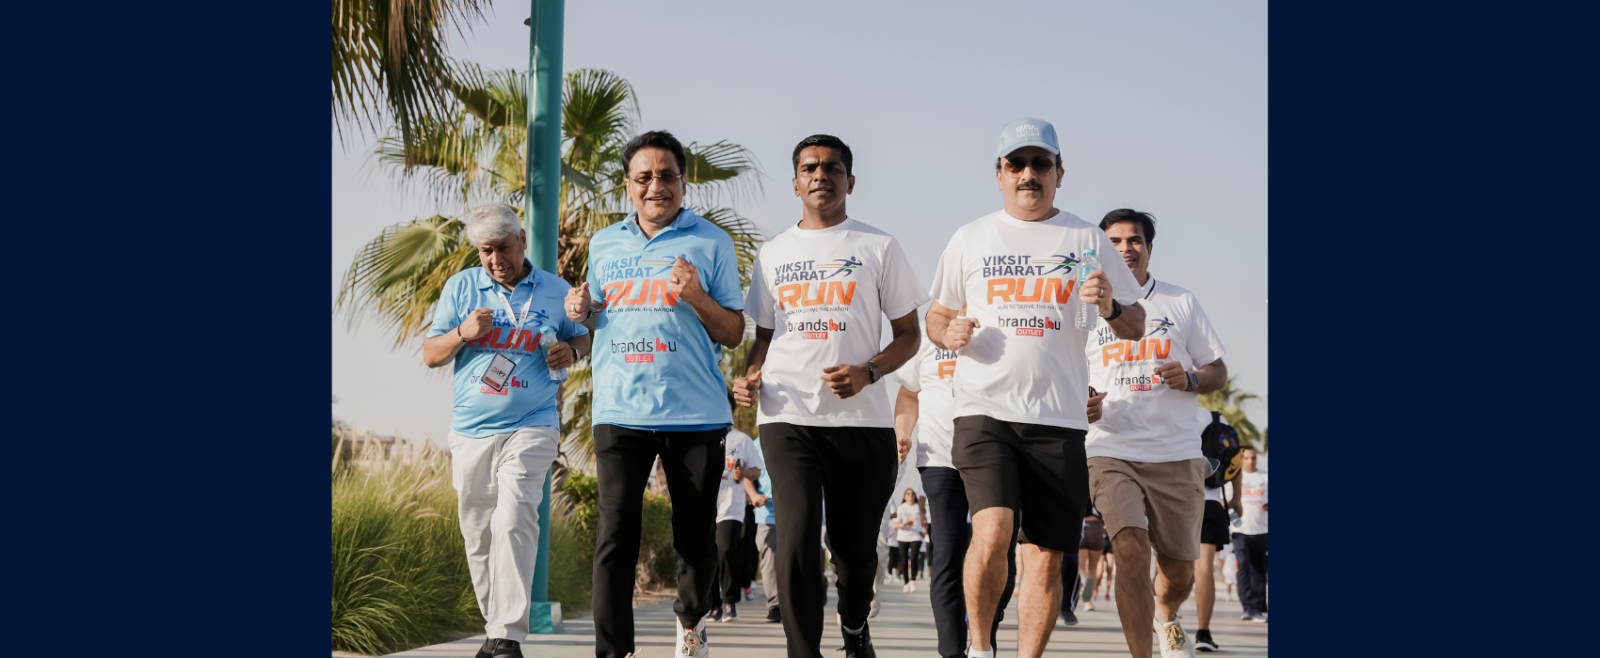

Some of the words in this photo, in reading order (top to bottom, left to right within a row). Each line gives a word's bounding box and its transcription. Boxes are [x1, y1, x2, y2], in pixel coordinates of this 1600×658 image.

[602, 256, 642, 273] VIKSIT
[775, 260, 815, 275] VIKSIT
[983, 255, 1031, 266] VIKSIT
[600, 267, 653, 285] BHARAT
[774, 270, 827, 286] BHARAT
[983, 266, 1045, 278] BHARAT
[602, 279, 678, 309] RUN
[778, 281, 857, 311] RUN
[987, 278, 1076, 305] RUN
[467, 328, 542, 353] RUN
[1017, 328, 1042, 336] OUTLET
[626, 354, 652, 362] OUTLET
[1102, 339, 1171, 367] RUN
